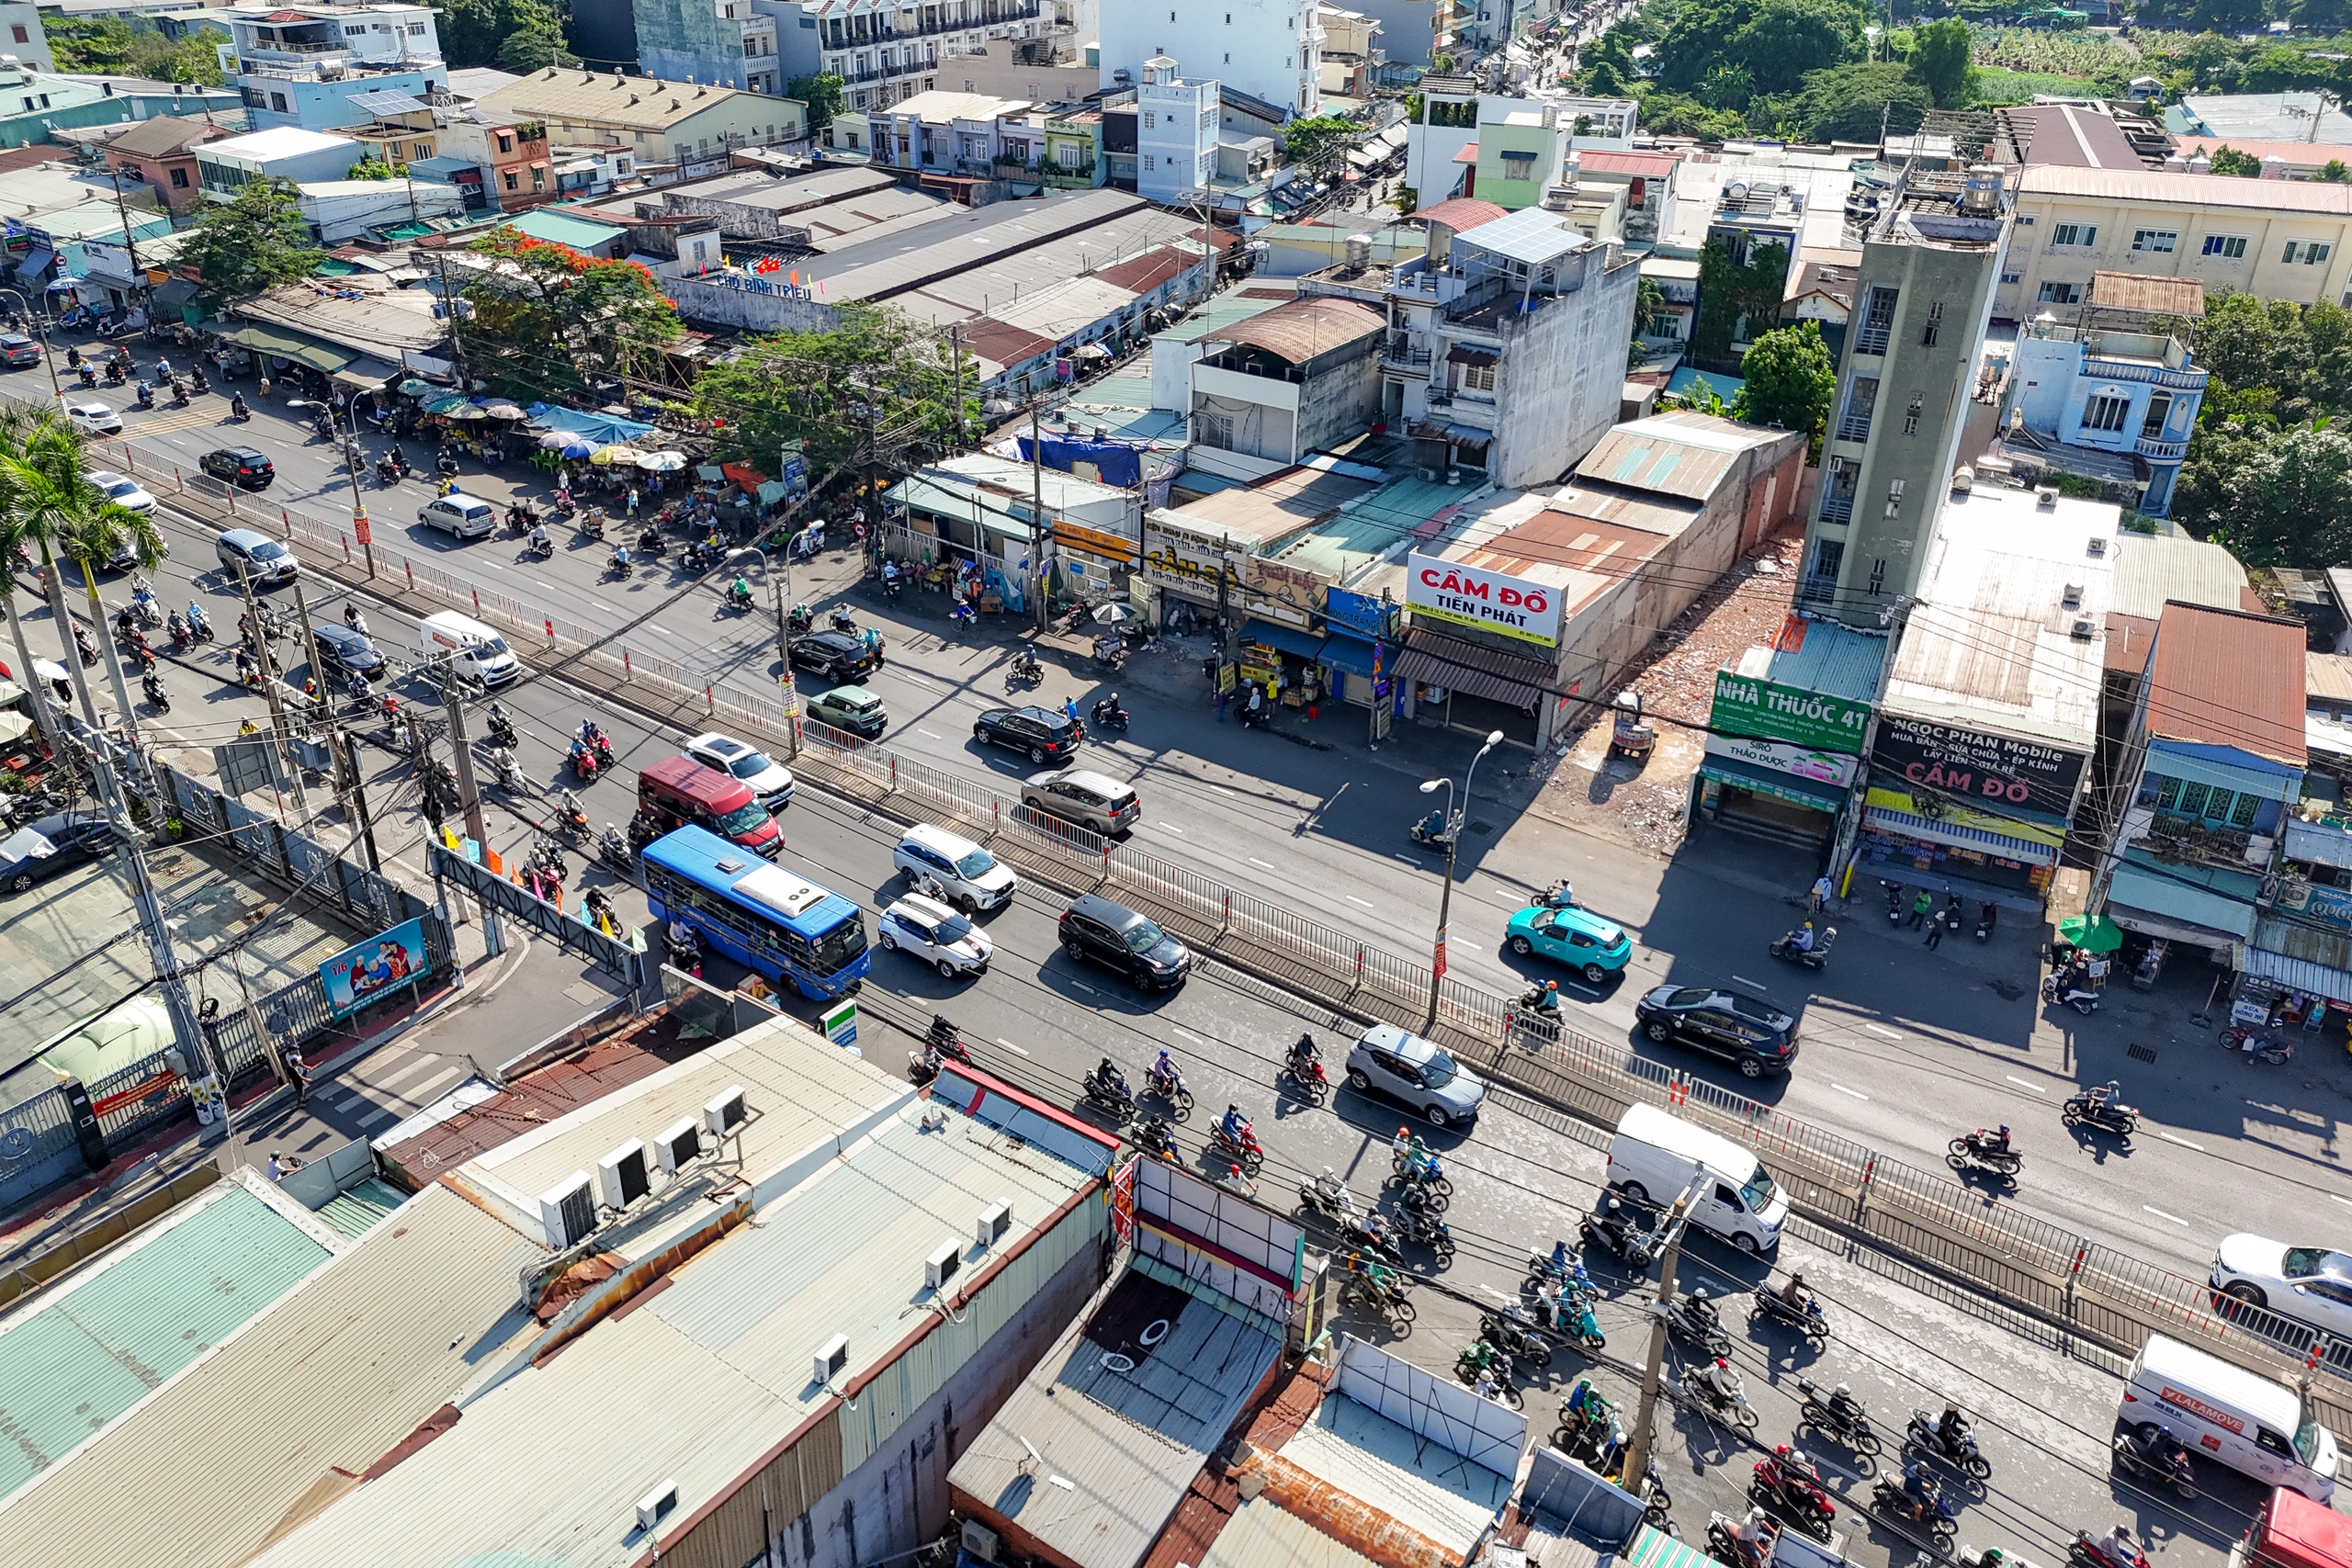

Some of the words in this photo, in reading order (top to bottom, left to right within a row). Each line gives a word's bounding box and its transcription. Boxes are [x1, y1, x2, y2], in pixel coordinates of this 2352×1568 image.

[1148, 546, 1199, 580] CẦM
[1420, 569, 1489, 601] CẦM
[1498, 589, 1547, 613] ĐỒ
[1481, 607, 1527, 627] PHÁT
[1716, 679, 1759, 705] NHÀ
[1766, 689, 1837, 724] THUỐC
[1840, 710, 1865, 730] 41
[1730, 746, 1757, 760] THẢO
[1758, 753, 1787, 768] DƯỢC
[1891, 732, 1913, 743] MUA
[1916, 736, 1938, 748] BÁN
[1972, 748, 2000, 761] CHỮA
[2011, 754, 2026, 765] ÉP
[2028, 759, 2058, 773] KÍNH
[1894, 719, 1945, 739] NGỌC
[2004, 740, 2064, 761] Mobile
[1923, 748, 1942, 760] LẤY
[1905, 761, 1971, 791] CẦM
[1982, 776, 2030, 803] ĐỒ
[332, 962, 348, 976] 1/6
[829, 1020, 854, 1038] FamilyMart
[841, 1032, 855, 1045] OPEN
[2176, 1393, 2244, 1430] LALAMOVE
